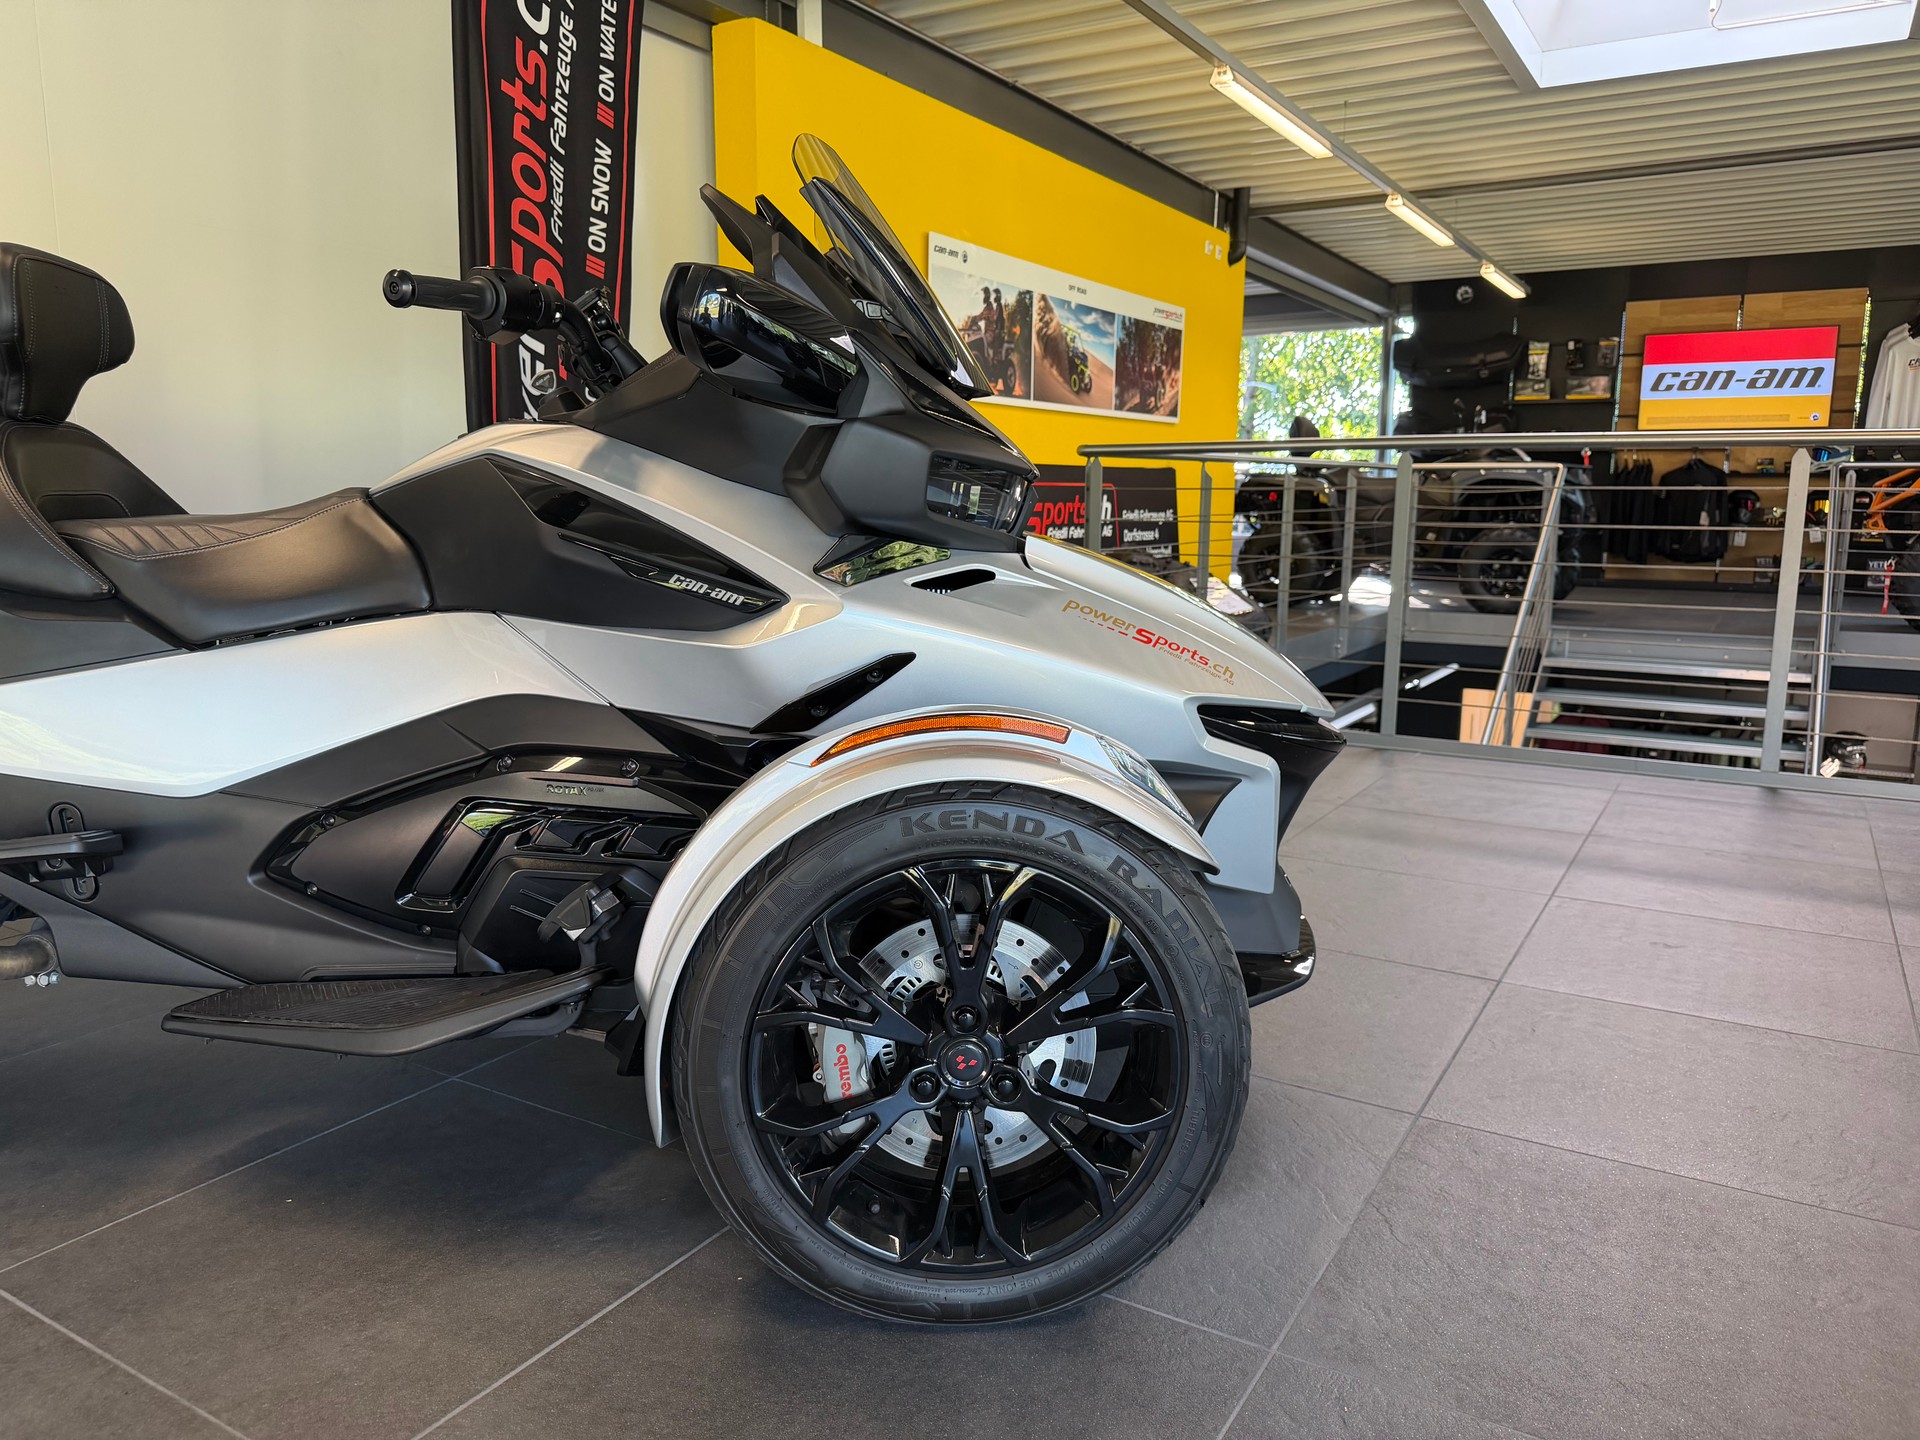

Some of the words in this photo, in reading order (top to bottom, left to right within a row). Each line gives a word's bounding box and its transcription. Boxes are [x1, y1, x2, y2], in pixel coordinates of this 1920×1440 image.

[550, 11, 577, 155] Fahrzeuge
[598, 65, 615, 102] ON
[591, 138, 612, 215] SNOW
[550, 157, 565, 244] Friedli
[588, 217, 609, 253] ON
[934, 245, 959, 258] can-am
[1650, 366, 1825, 392] can-am
[1101, 524, 1113, 537] AG
[669, 573, 745, 606] can-am
[1062, 599, 1235, 680] powerSports.ch
[1223, 677, 1235, 686] AG
[546, 783, 588, 796] ROTAX
[899, 809, 1085, 855] KENDA
[1106, 855, 1221, 1018] RADIAL
[833, 1043, 855, 1099] rembo
[1178, 1110, 1200, 1158] TUBELESS
[1119, 1198, 1156, 1236] SPECIAL
[1046, 1237, 1118, 1280] MOTORCYCLE
[986, 1282, 1014, 1296] ONLY
[1020, 1276, 1041, 1290] USE
